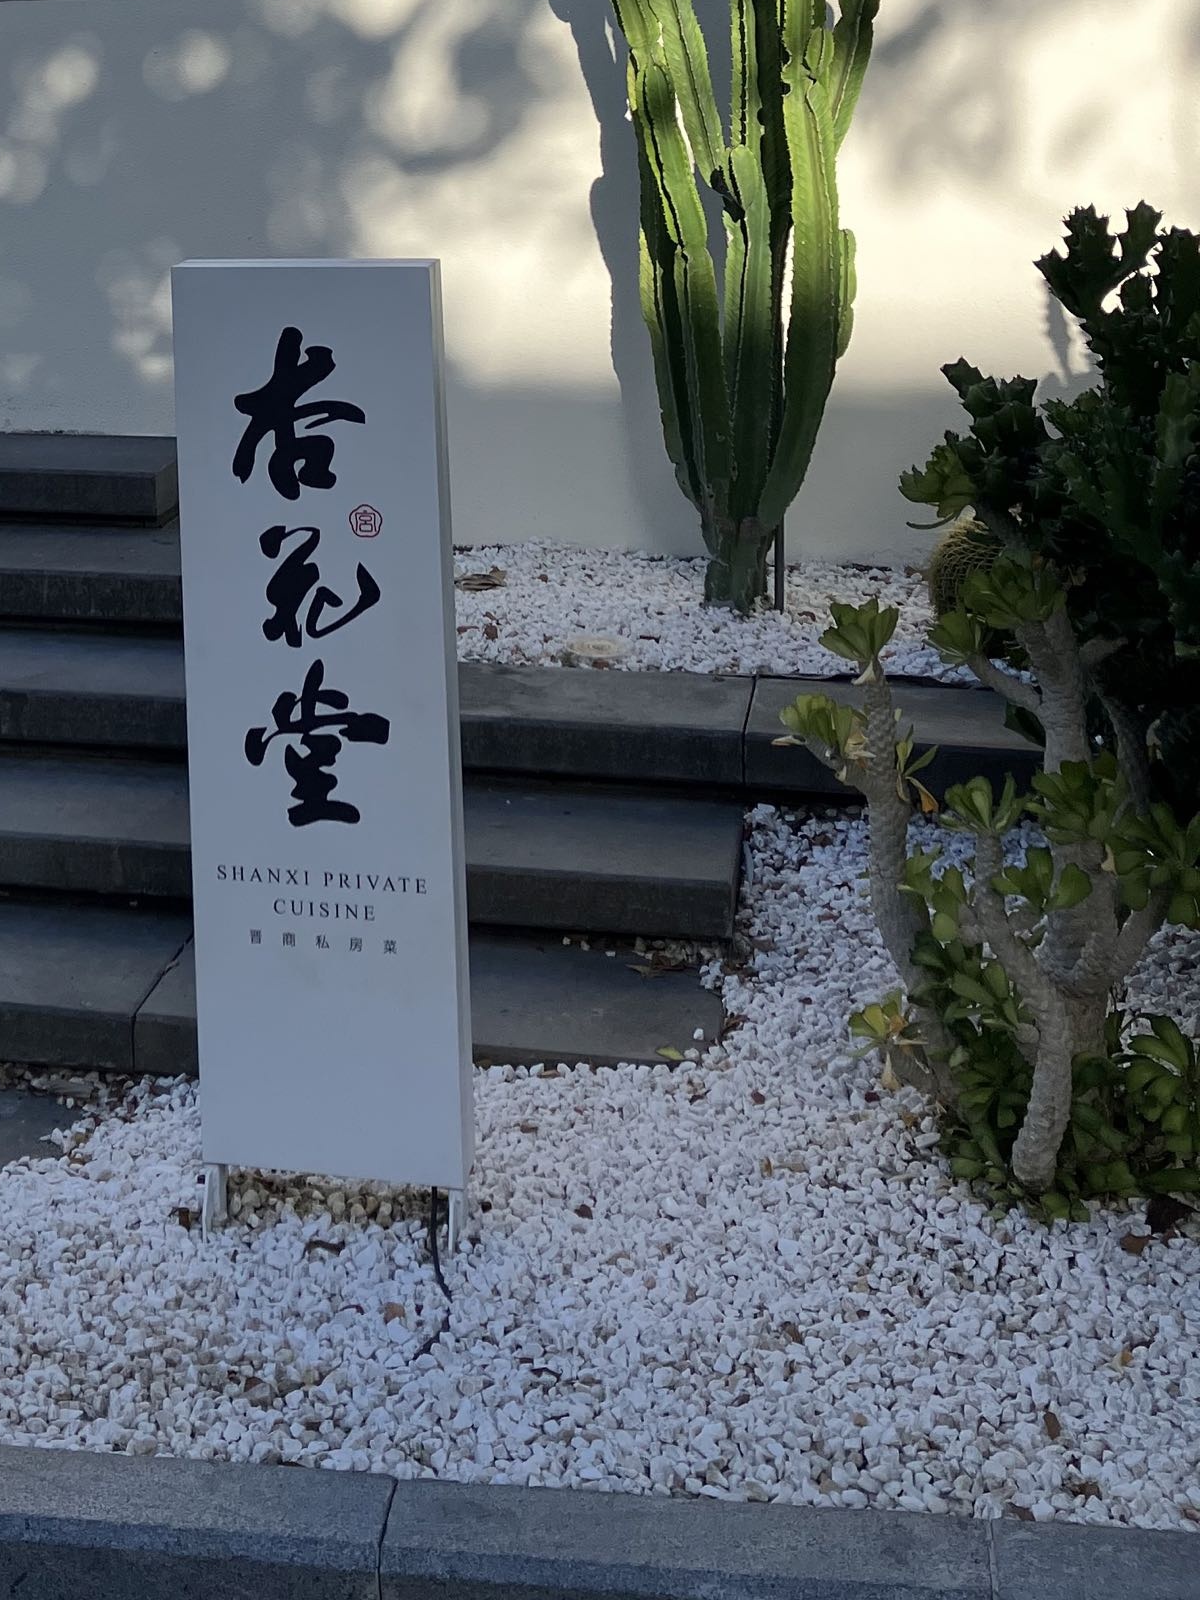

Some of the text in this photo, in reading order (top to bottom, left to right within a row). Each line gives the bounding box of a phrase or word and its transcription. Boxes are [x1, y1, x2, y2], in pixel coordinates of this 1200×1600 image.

[232, 326, 391, 828] 杏花堂
[216, 864, 428, 895] SHANXI PRIVATE
[273, 898, 376, 922] CUISINE
